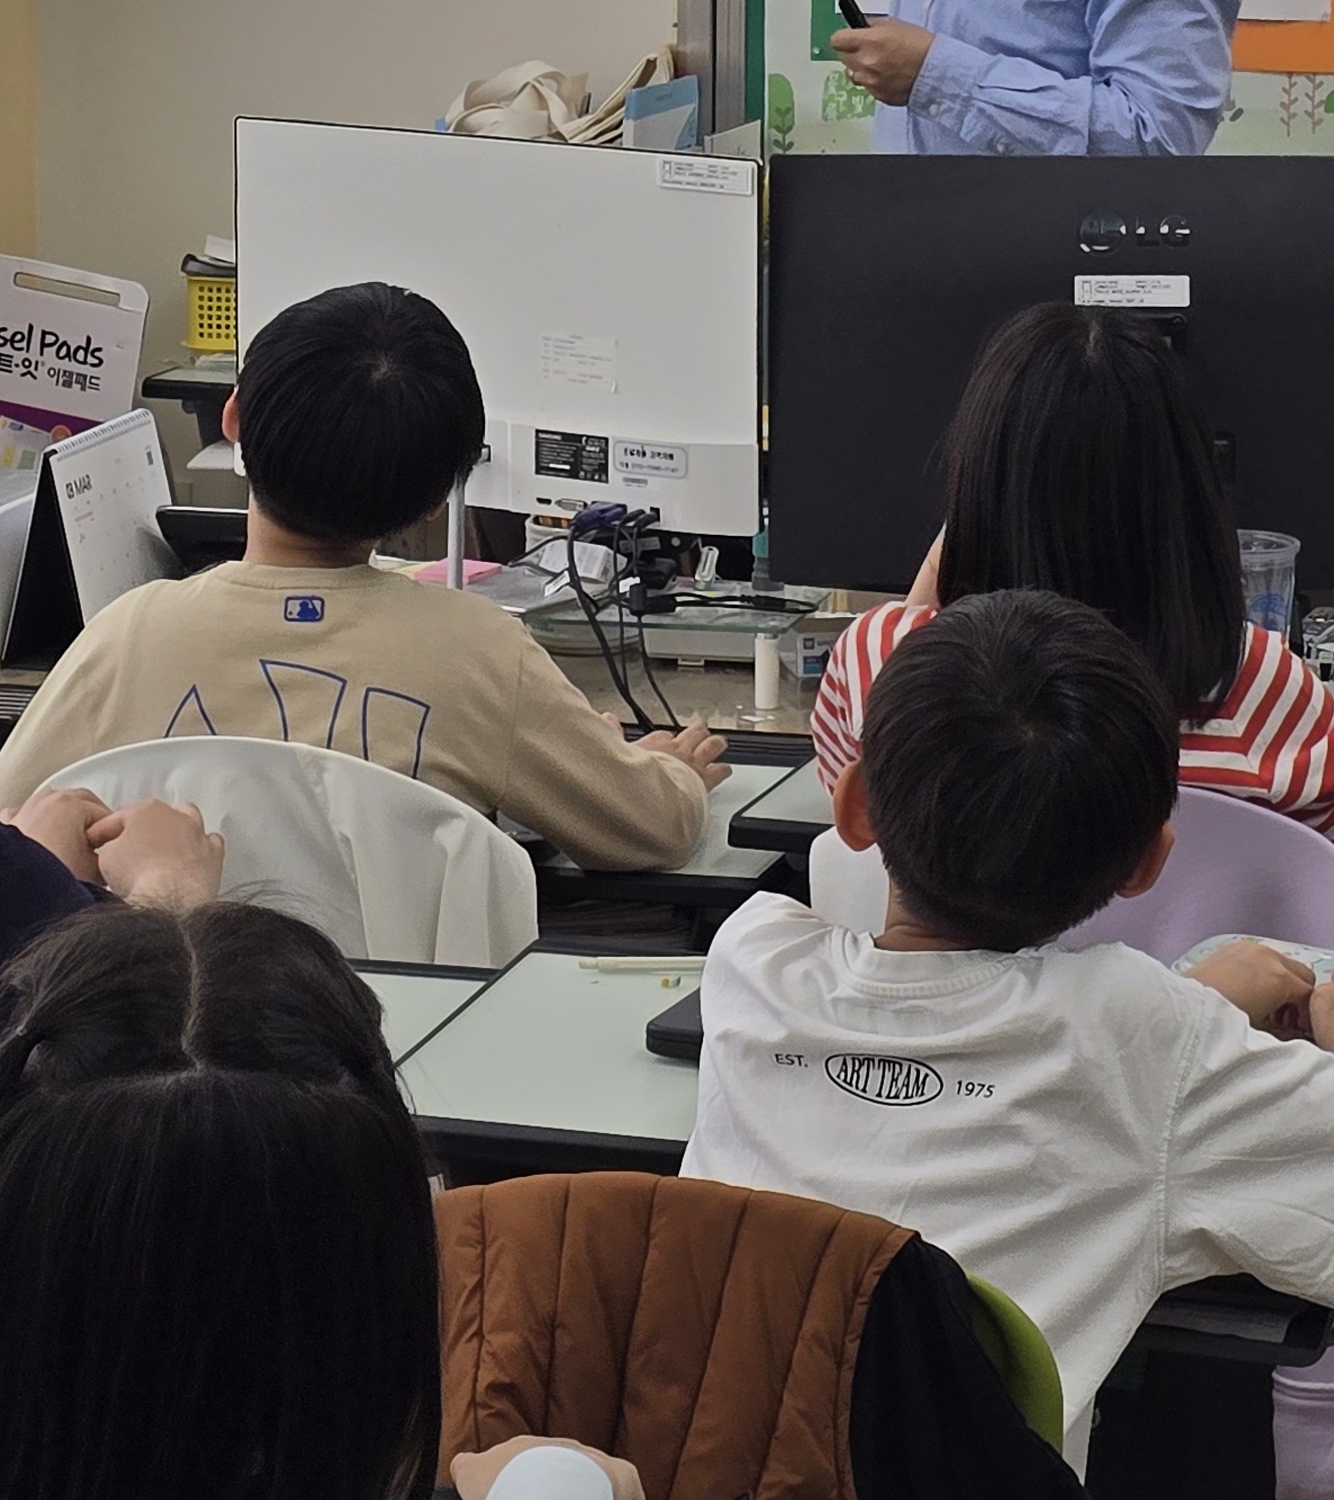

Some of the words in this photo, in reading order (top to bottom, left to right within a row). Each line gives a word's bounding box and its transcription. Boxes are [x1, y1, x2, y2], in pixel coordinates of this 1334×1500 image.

[39, 329, 104, 368] Pads
[47, 367, 101, 392] 이젤패드
[74, 474, 93, 496] MAR
[775, 1053, 808, 1068] EST.
[836, 1057, 878, 1094] ART
[875, 1058, 929, 1100] TEAM
[955, 1080, 995, 1098] 1975
